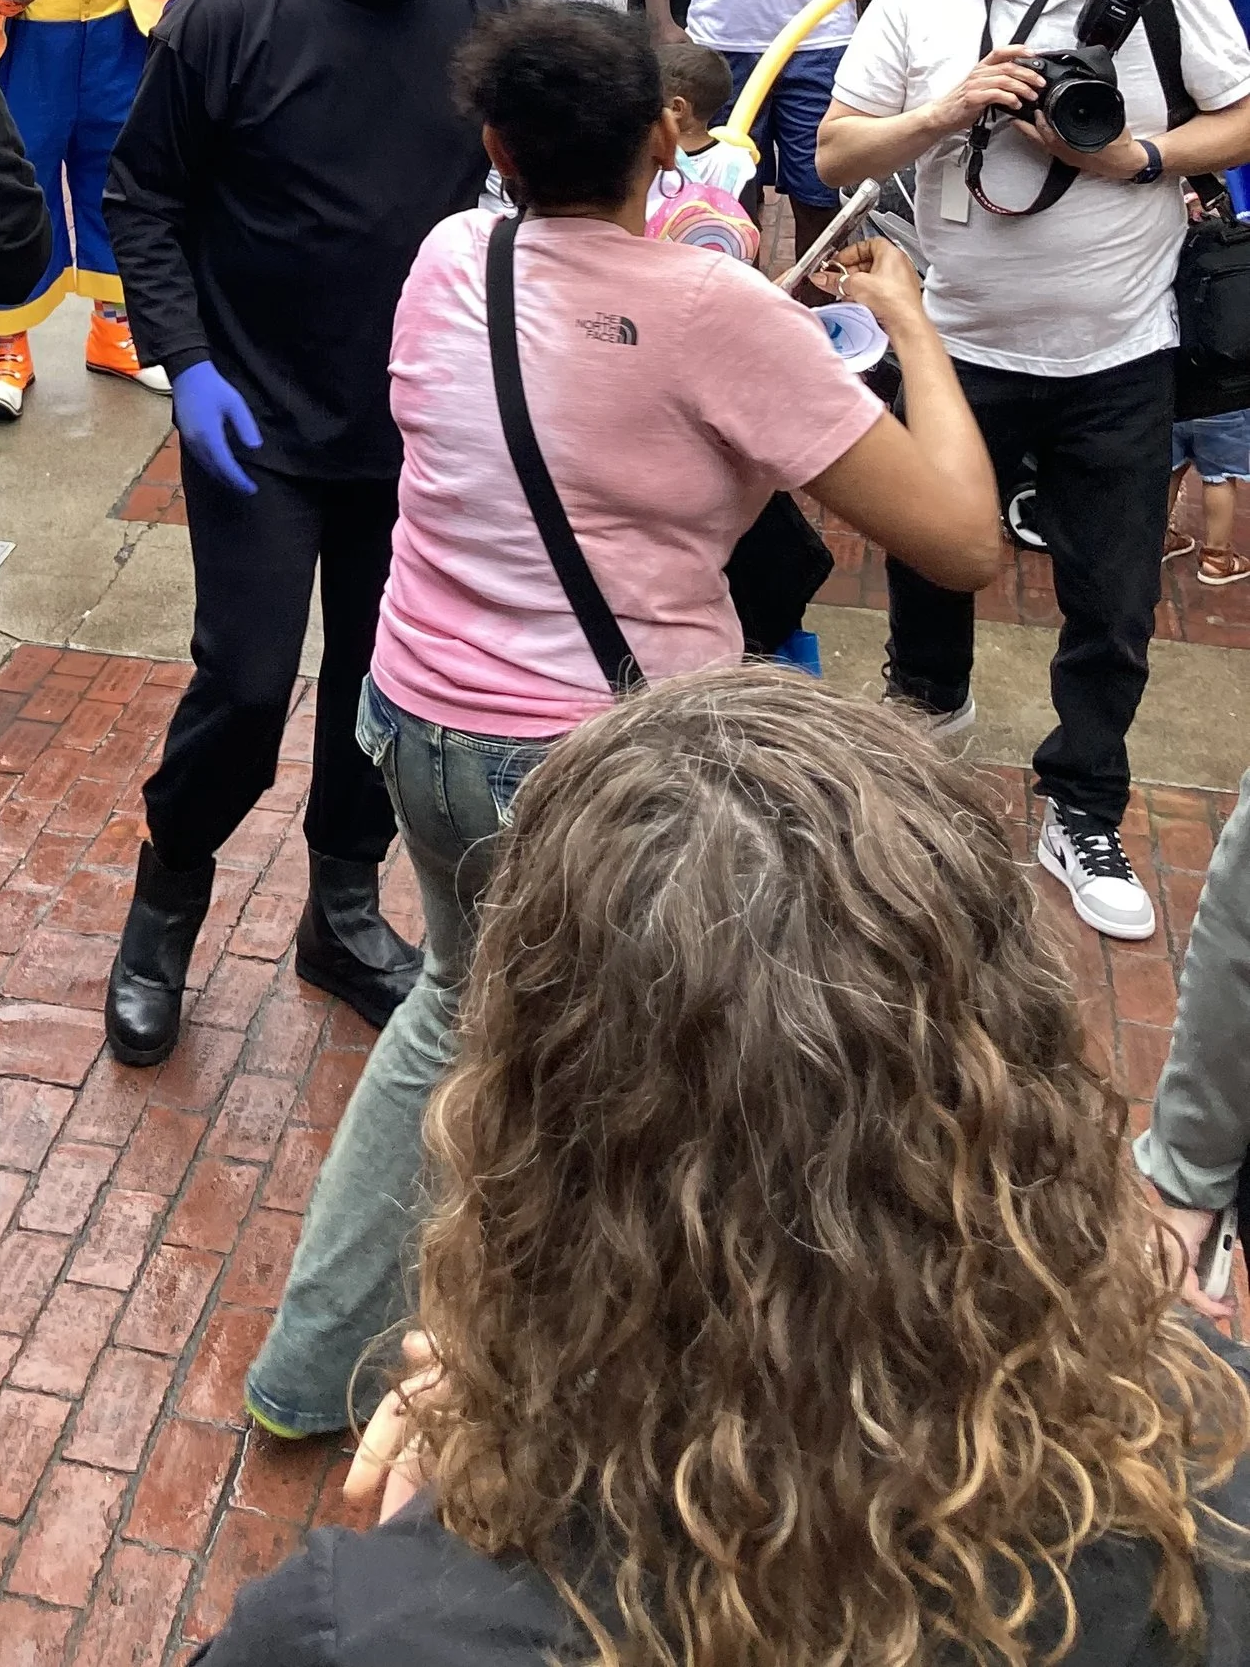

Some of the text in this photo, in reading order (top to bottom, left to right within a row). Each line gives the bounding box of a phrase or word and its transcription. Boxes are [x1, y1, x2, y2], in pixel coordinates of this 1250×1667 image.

[594, 311, 620, 324] THE
[575, 318, 620, 334] NORTH
[586, 329, 620, 344] FACE
